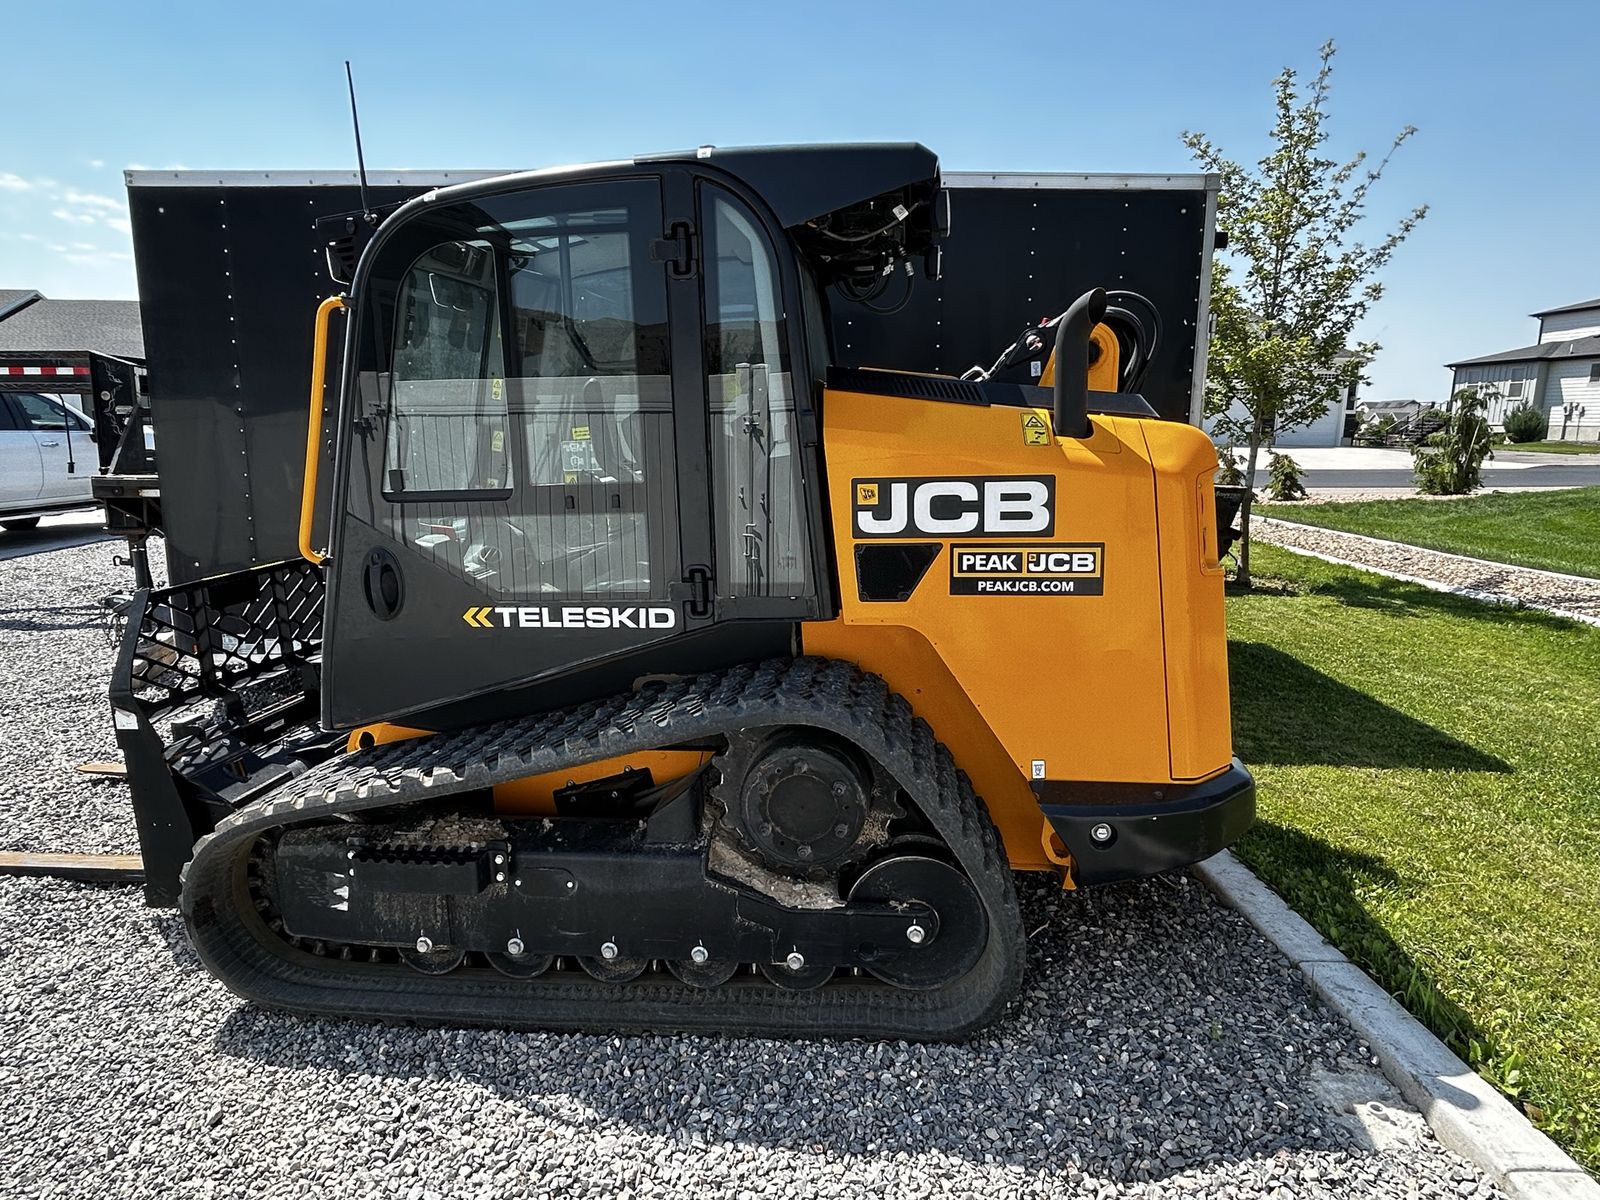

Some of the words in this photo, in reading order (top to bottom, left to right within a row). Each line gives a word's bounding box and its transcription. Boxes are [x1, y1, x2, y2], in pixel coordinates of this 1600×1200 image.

[857, 480, 1050, 534] JCB
[961, 554, 1018, 571] PEAK
[1028, 553, 1095, 572] JCB
[977, 581, 1075, 593] PEAKJCB.COM
[494, 607, 676, 629] TELESKID
